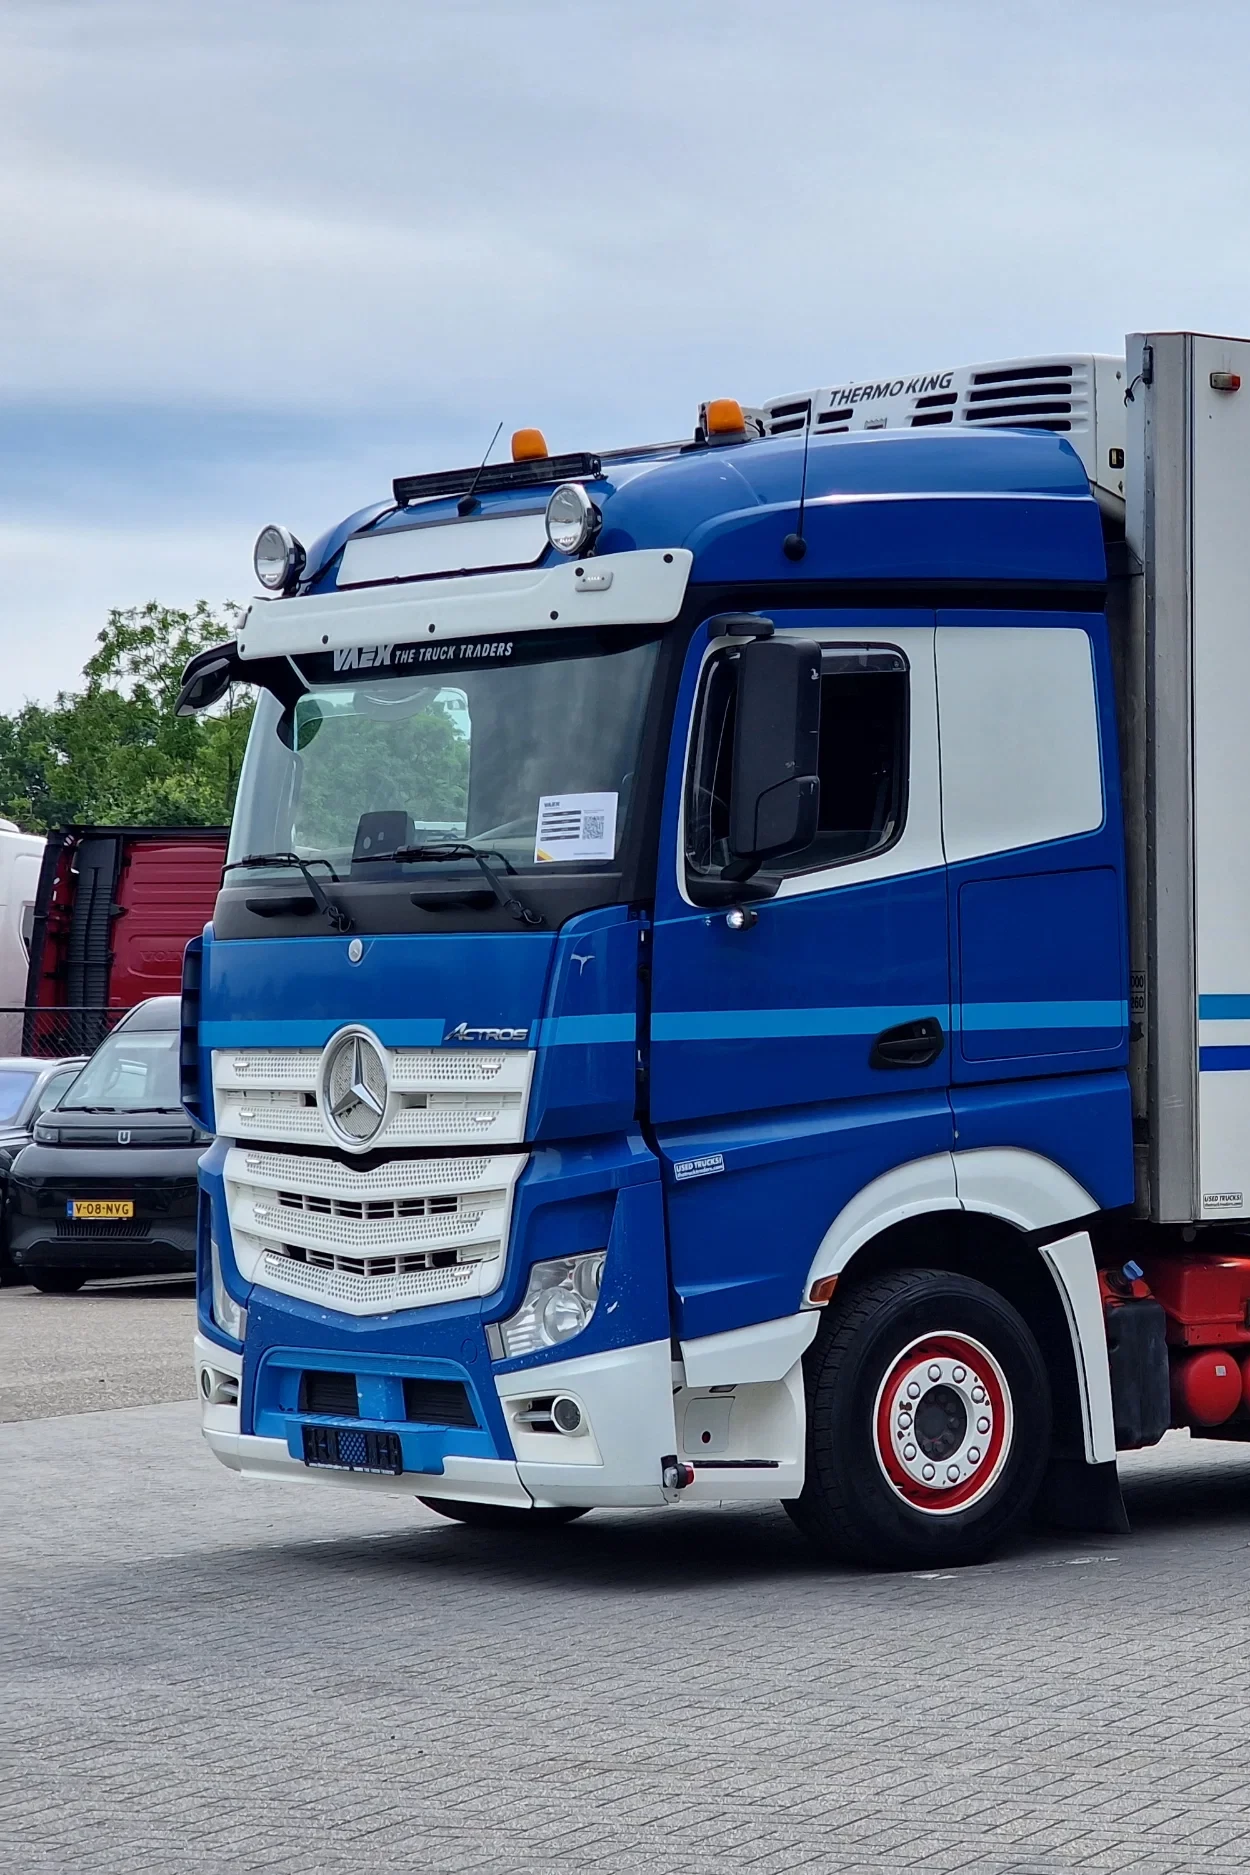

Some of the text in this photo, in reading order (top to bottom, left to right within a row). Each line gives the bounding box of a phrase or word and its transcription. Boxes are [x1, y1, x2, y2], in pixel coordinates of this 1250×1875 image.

[829, 372, 954, 407] THERMO KING
[333, 642, 513, 672] VAEX THE TRUCK TRADERS
[443, 1022, 529, 1041] ACTROS
[676, 1163, 694, 1172] USED
[75, 1203, 129, 1215] V-08-NVG
